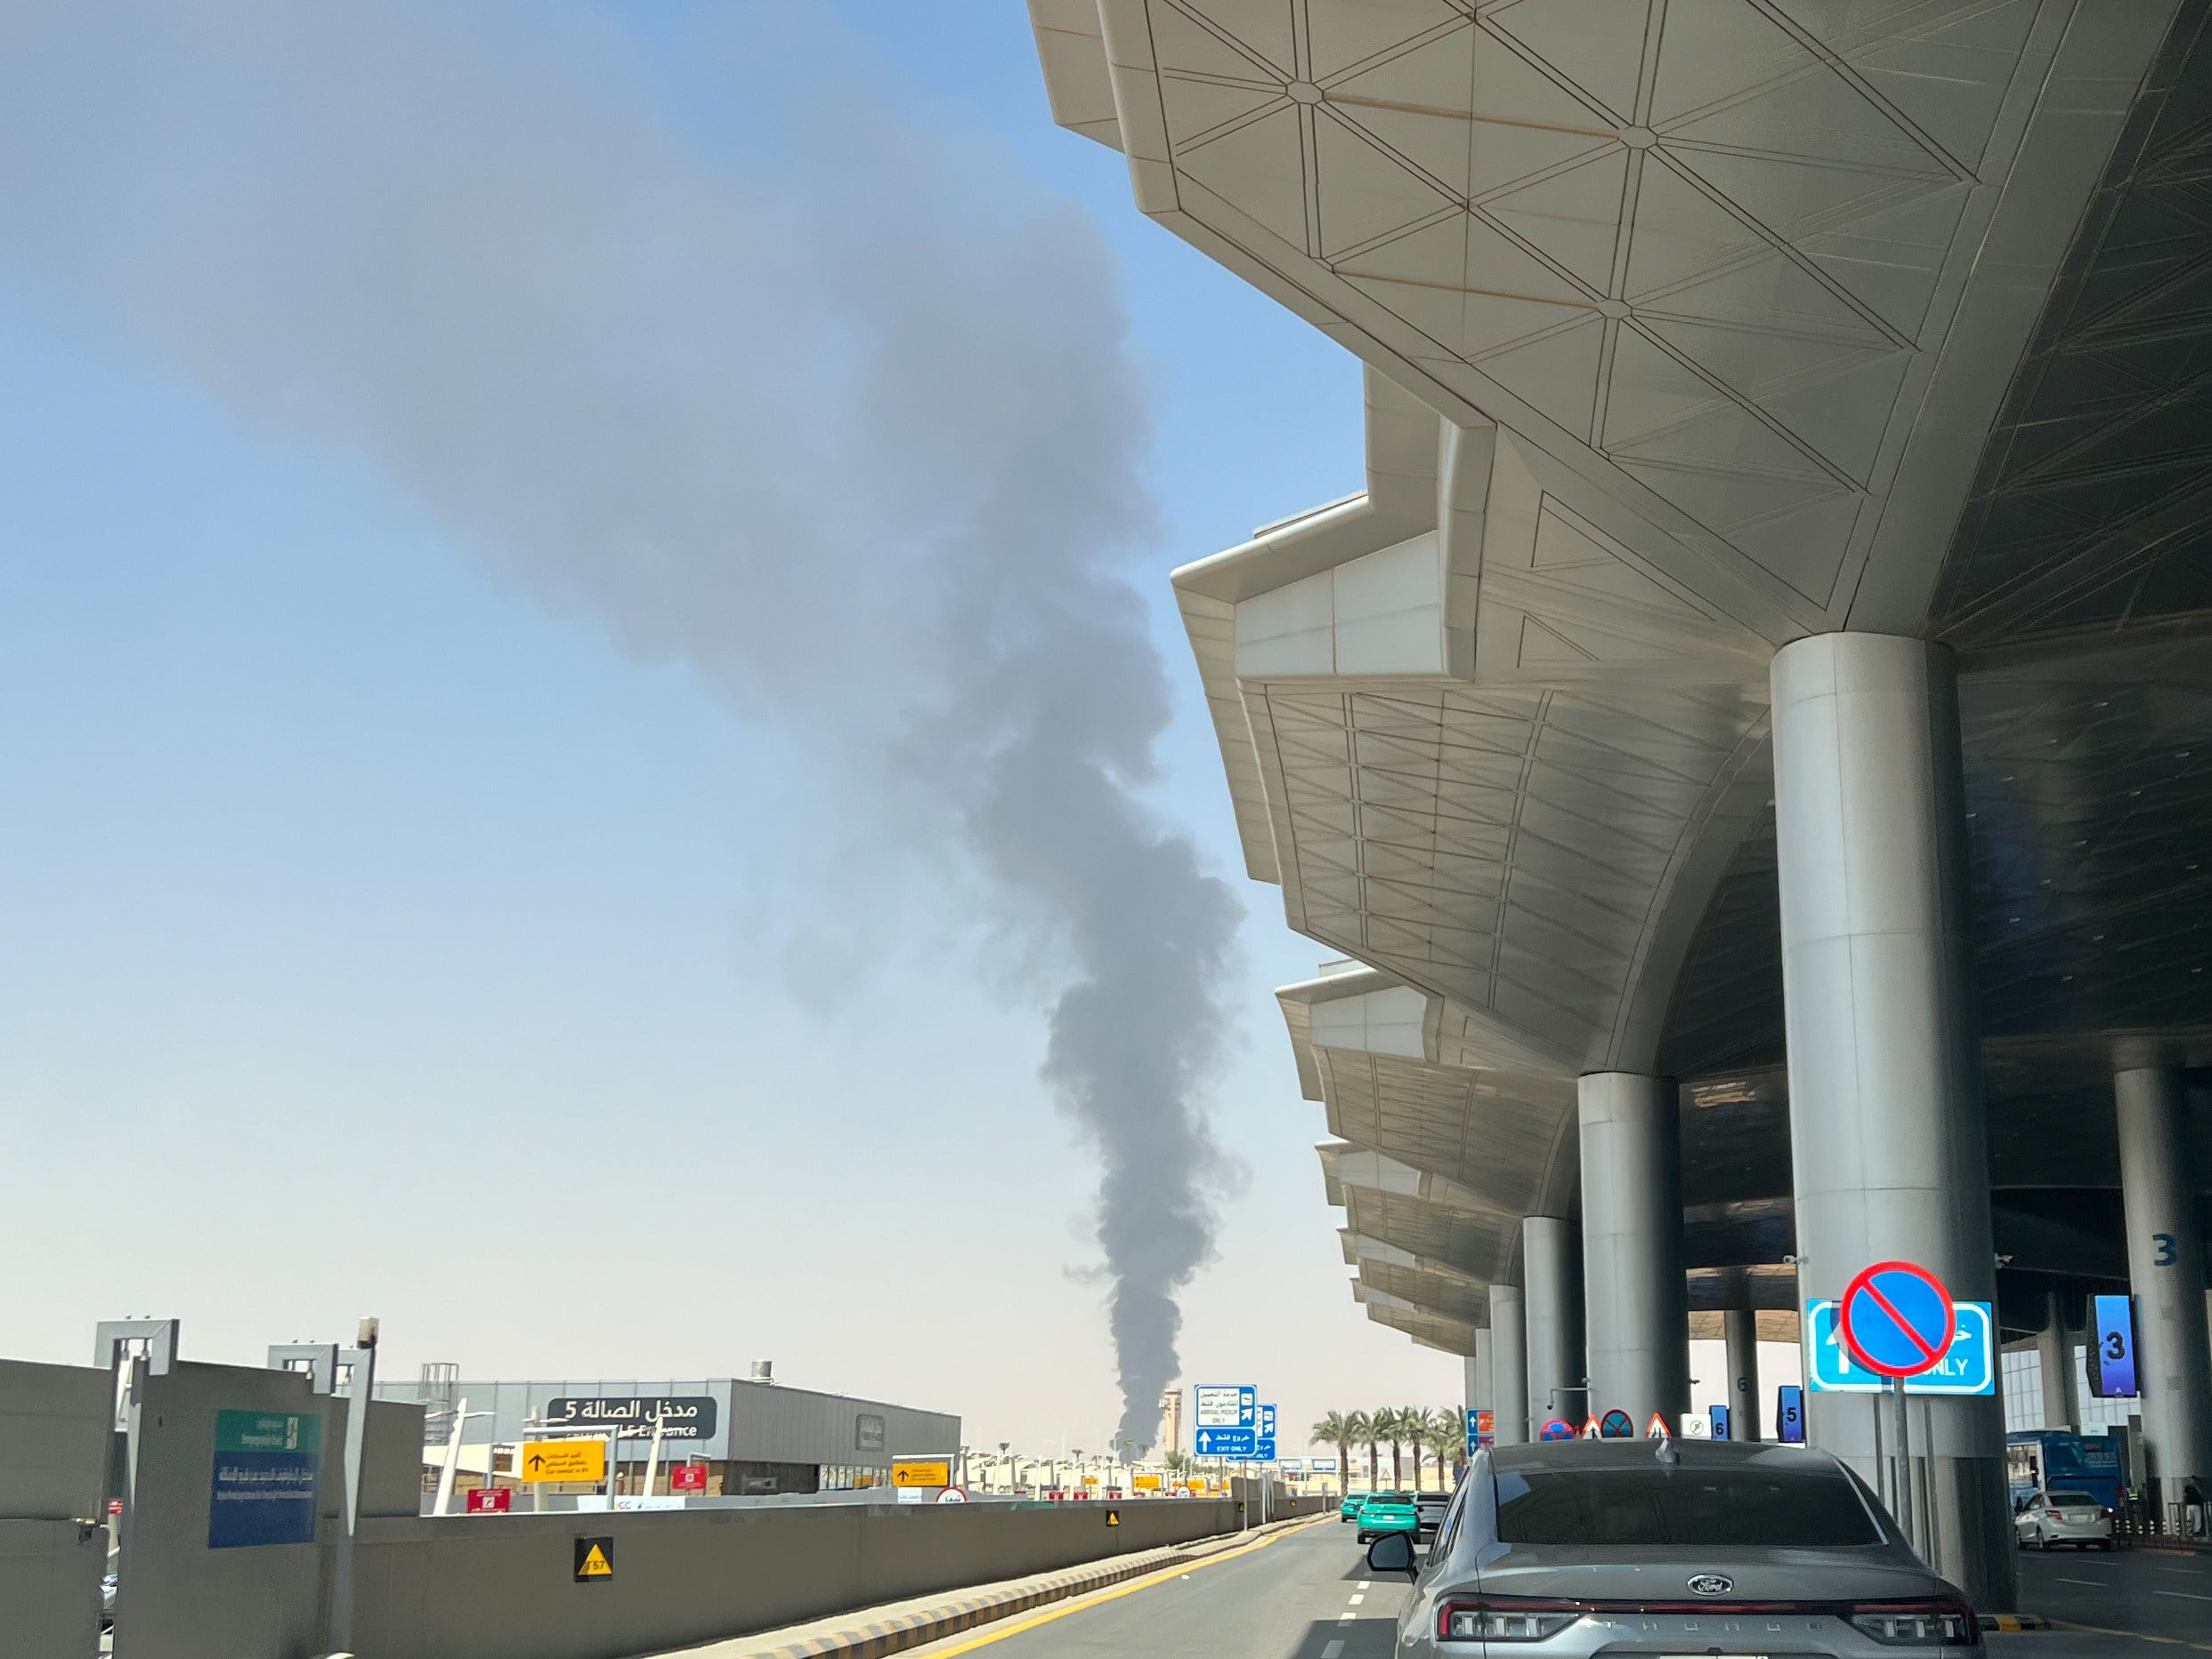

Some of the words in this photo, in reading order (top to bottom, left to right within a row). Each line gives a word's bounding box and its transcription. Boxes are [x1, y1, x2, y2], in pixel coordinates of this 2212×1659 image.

[2152, 1233, 2176, 1267] 3
[2106, 1331, 2125, 1360] 3
[565, 1400, 578, 1419] 5
[581, 1400, 641, 1419] الصالة
[644, 1400, 698, 1422] مدخل
[1787, 1407, 1797, 1422] 5
[1715, 1422, 1724, 1436] 6
[1697, 1580, 1724, 1592] Ford
